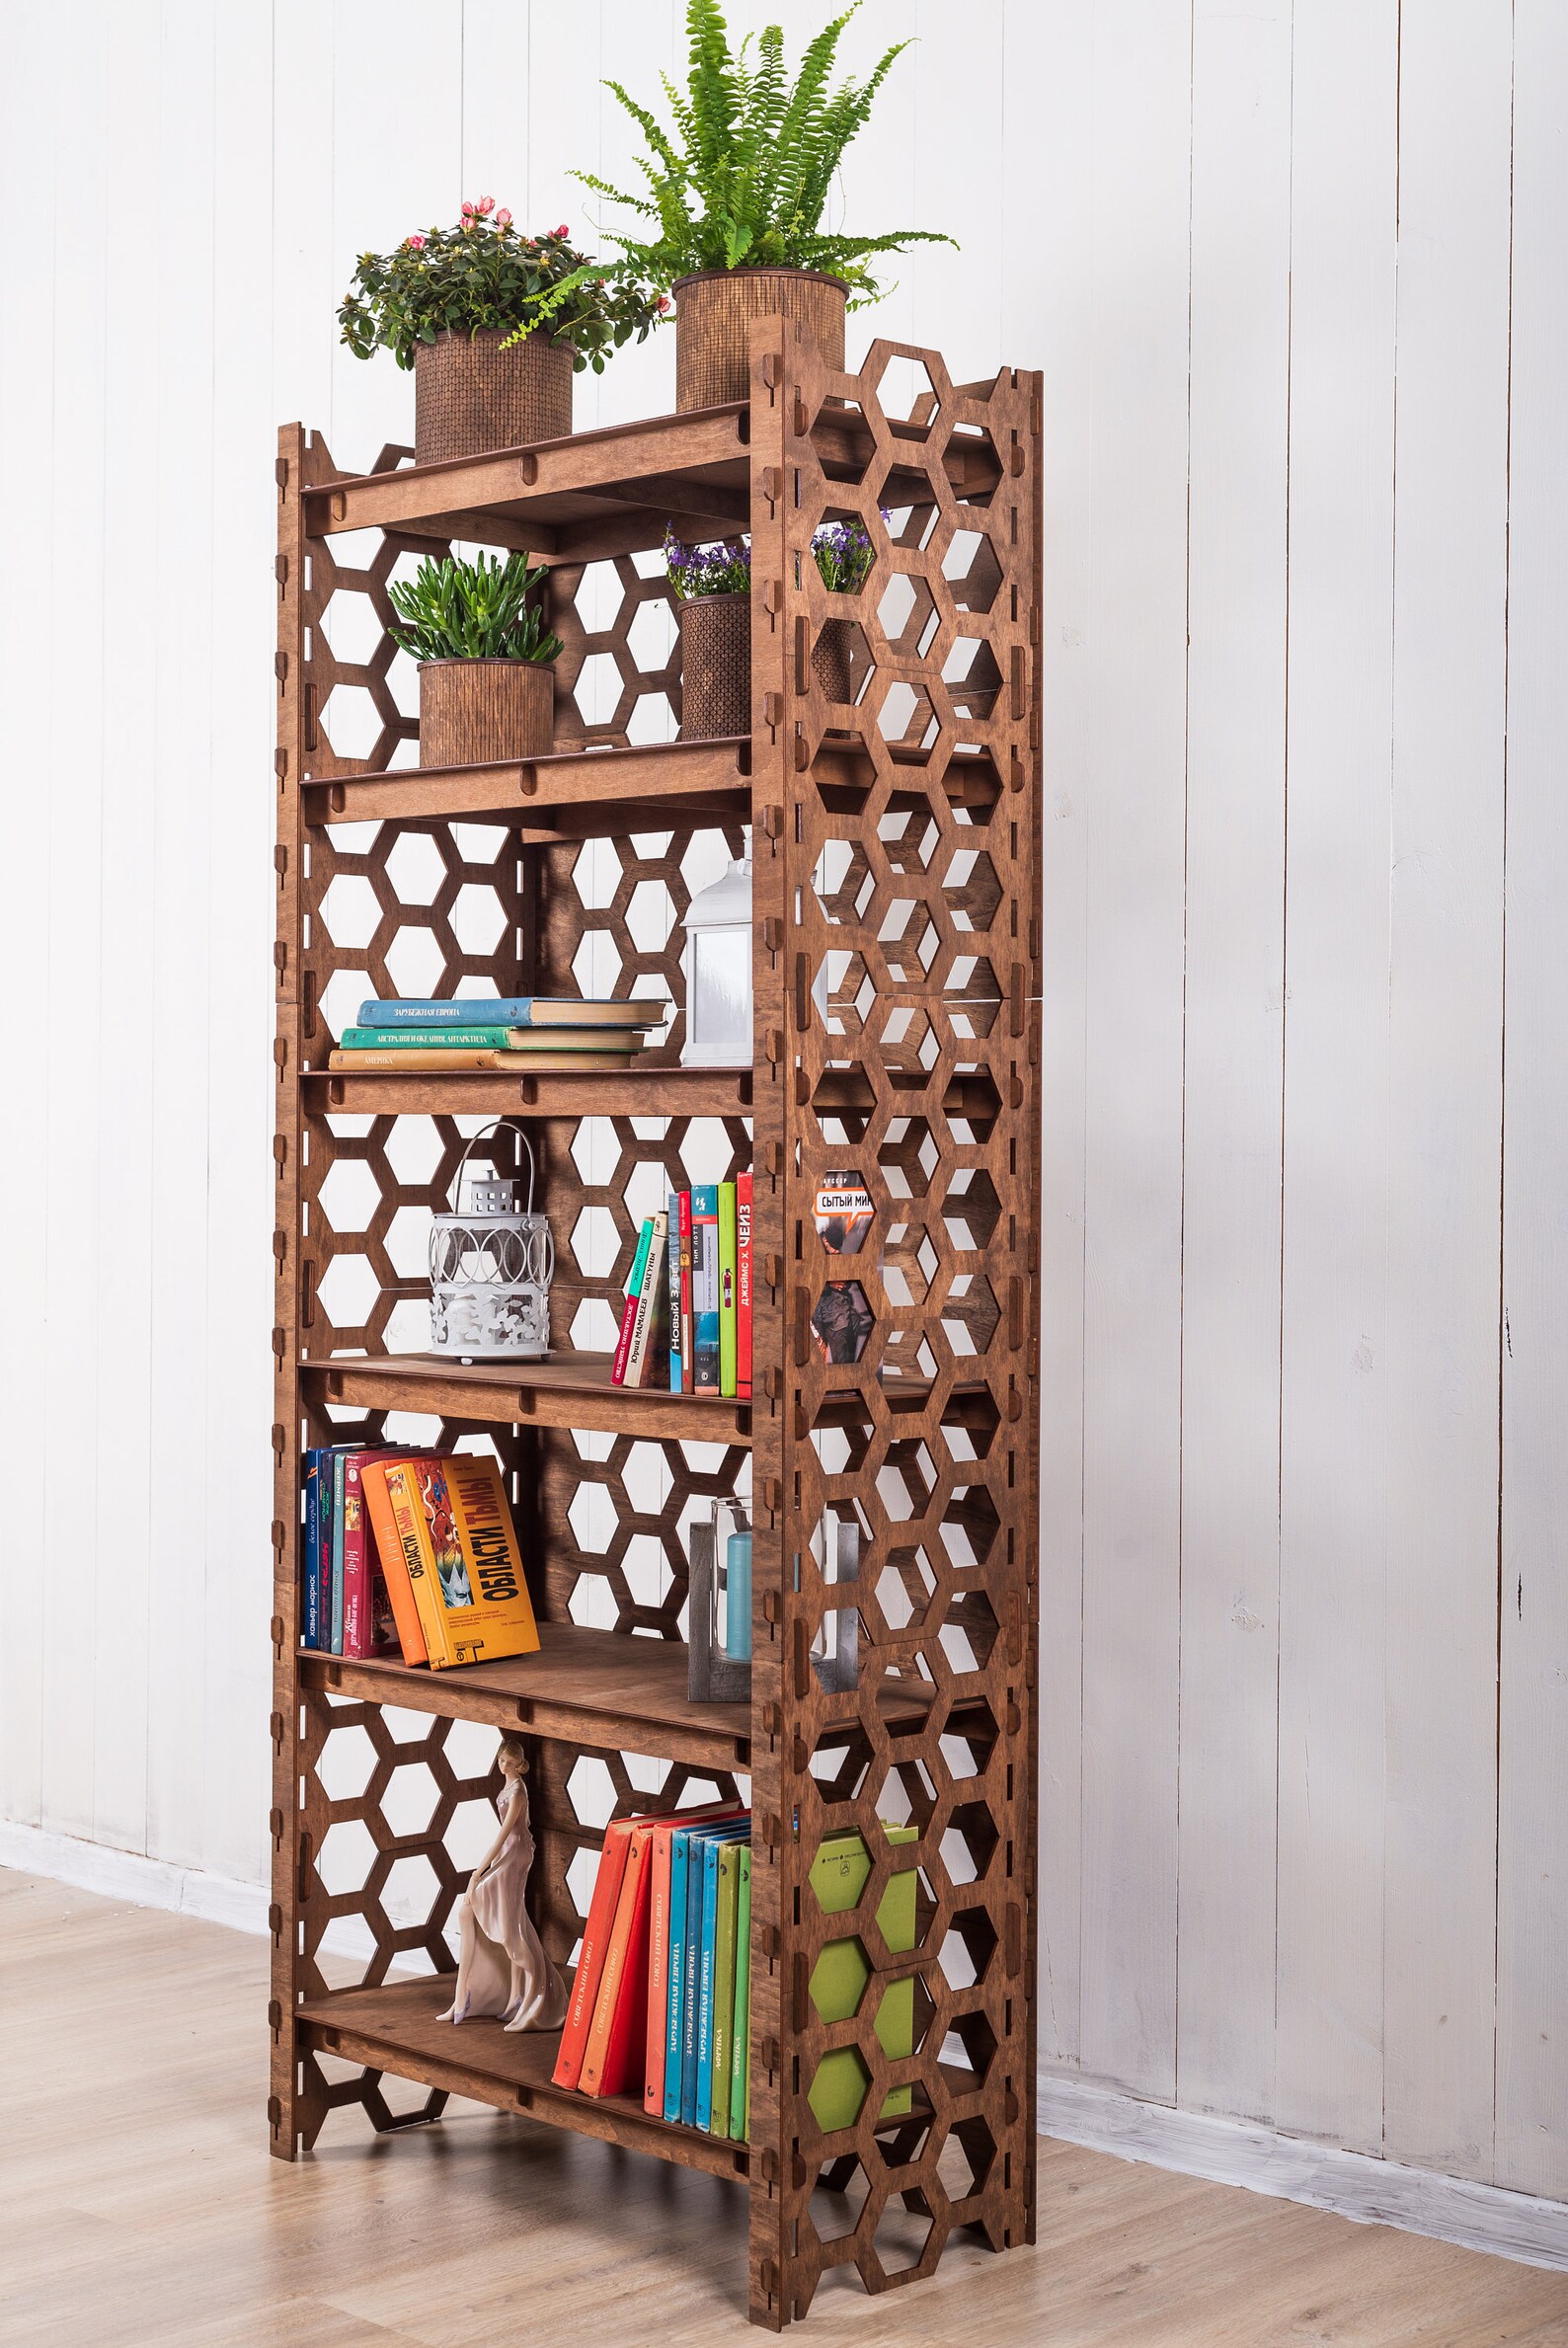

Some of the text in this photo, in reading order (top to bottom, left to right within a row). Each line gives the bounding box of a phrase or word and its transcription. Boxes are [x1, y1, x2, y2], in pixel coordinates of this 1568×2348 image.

[435, 1008, 460, 1017] ЕВРОПА
[363, 1057, 394, 1065] АМЕРИКА
[822, 1194, 853, 1208] СЫТЫЙ
[630, 1252, 656, 1364] Юрий МАМЛЕЕВ ШАТУНЫ
[740, 1262, 749, 1306] ДЖЕЙМС
[456, 1476, 502, 1526] ТЬМЫ
[395, 1506, 425, 1579] ОБЛАСТИ ТЬМЫ
[467, 1525, 519, 1603] ОБЛАСТИ
[572, 1940, 593, 2027] СОВЕТСКИЙ СОЮЗ
[596, 1947, 618, 2034] СОВЕТСКИЙ СОЮЗ
[699, 1950, 710, 2064] ЗАРУБЕЖНАЯ ЕВРОПА
[669, 1985, 679, 2054] ЗАРУБЕЖНАЯ
